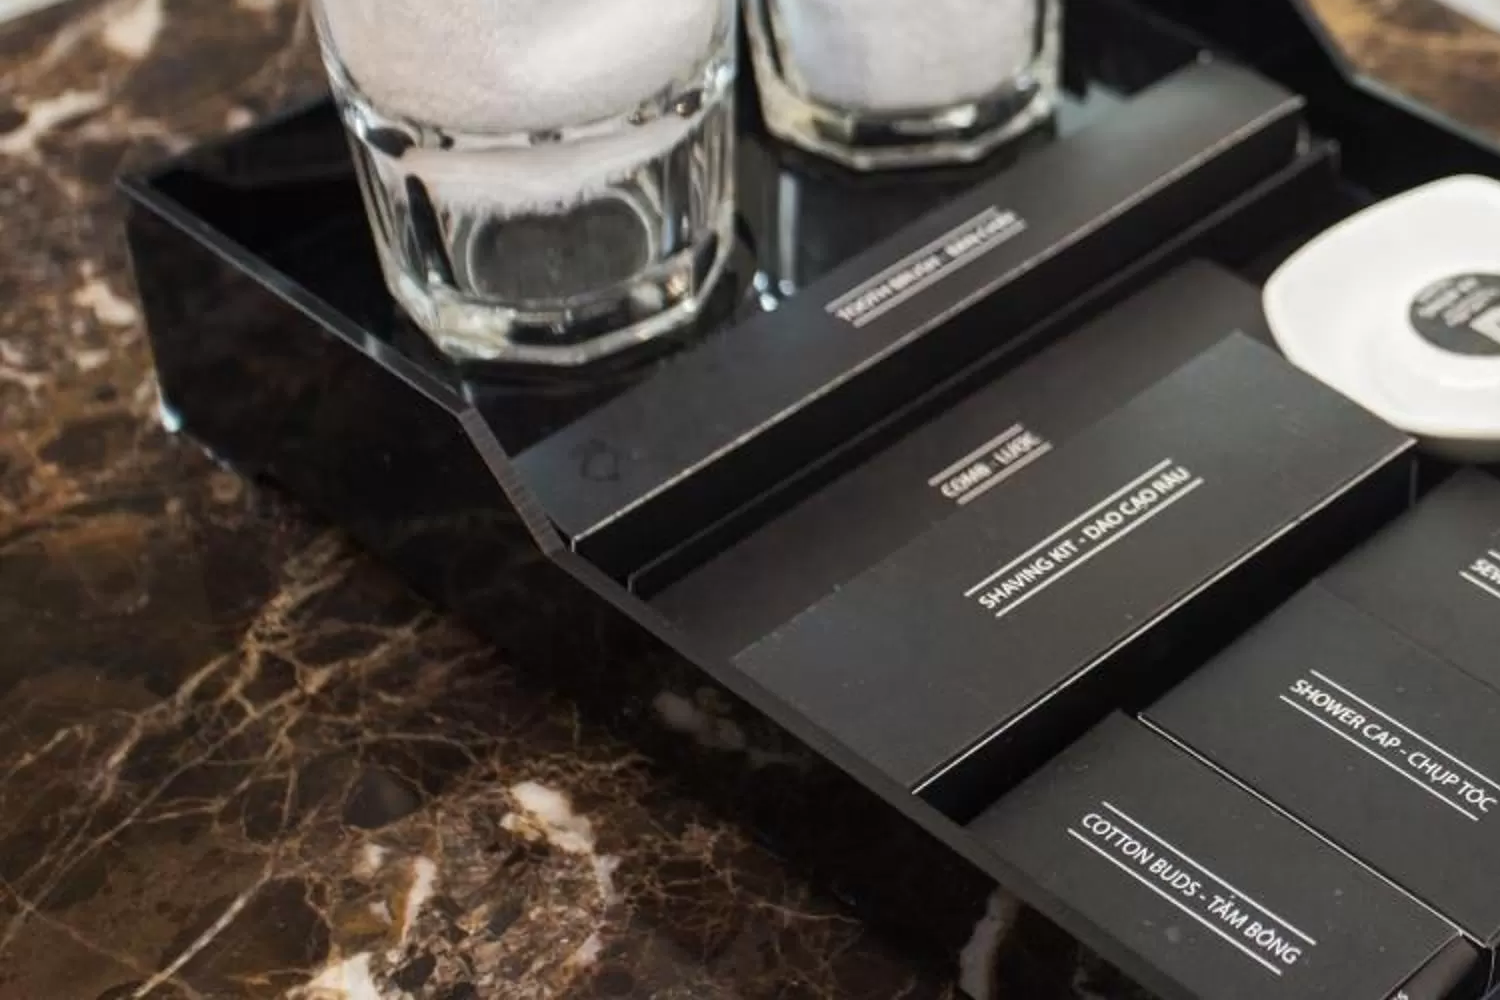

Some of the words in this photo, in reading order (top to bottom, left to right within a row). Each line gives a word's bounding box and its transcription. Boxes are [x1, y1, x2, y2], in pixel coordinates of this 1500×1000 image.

[978, 556, 1055, 609] SHAVING
[1049, 539, 1079, 564] KIT
[1082, 511, 1124, 541] DAO
[1289, 679, 1367, 730] SHOWER
[1362, 723, 1402, 749] CAP
[1081, 812, 1155, 865] COTTON
[1149, 858, 1203, 898] BUDS
